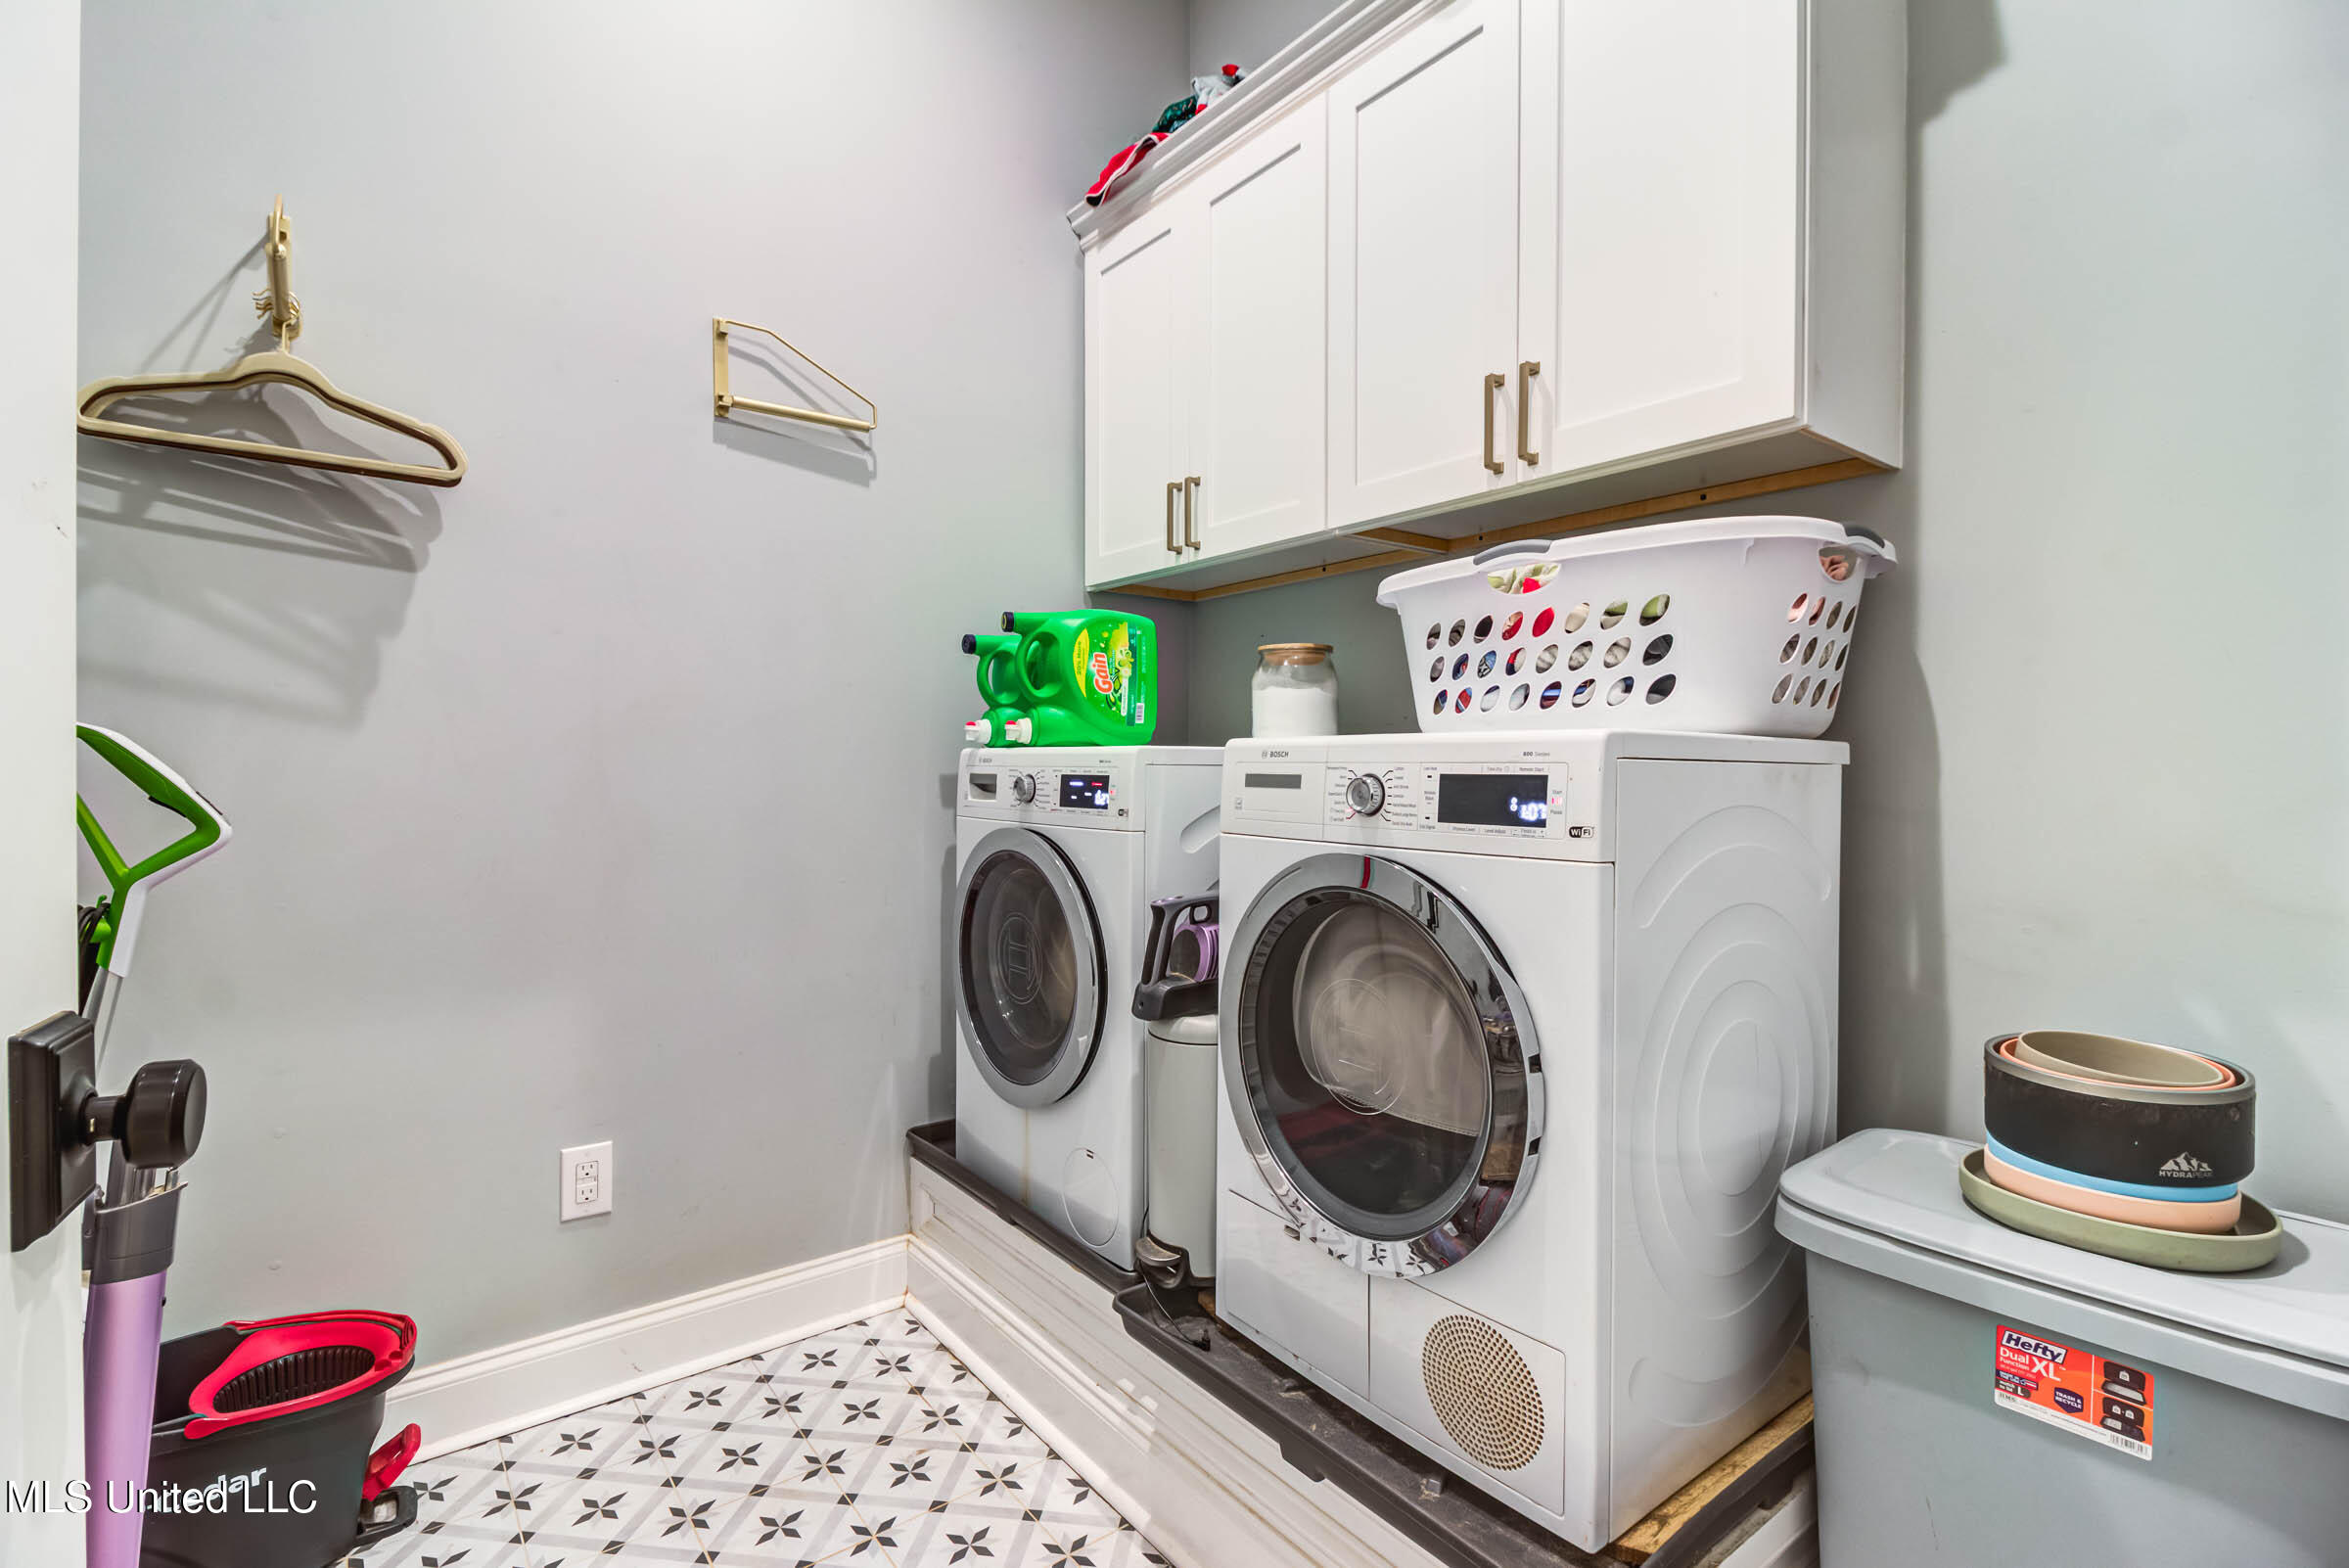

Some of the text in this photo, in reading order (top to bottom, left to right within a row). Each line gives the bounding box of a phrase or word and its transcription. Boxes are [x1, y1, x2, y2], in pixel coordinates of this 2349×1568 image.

[1092, 652, 1113, 694] Gain
[2005, 1333, 2063, 1361] Hefty
[2000, 1357, 2030, 1370] Function
[2000, 1346, 2030, 1364] Dual
[2031, 1357, 2062, 1382] XL
[2017, 1385, 2025, 1396] L
[2055, 1391, 2076, 1402] TRASH
[2055, 1396, 2082, 1409] RECYCLE
